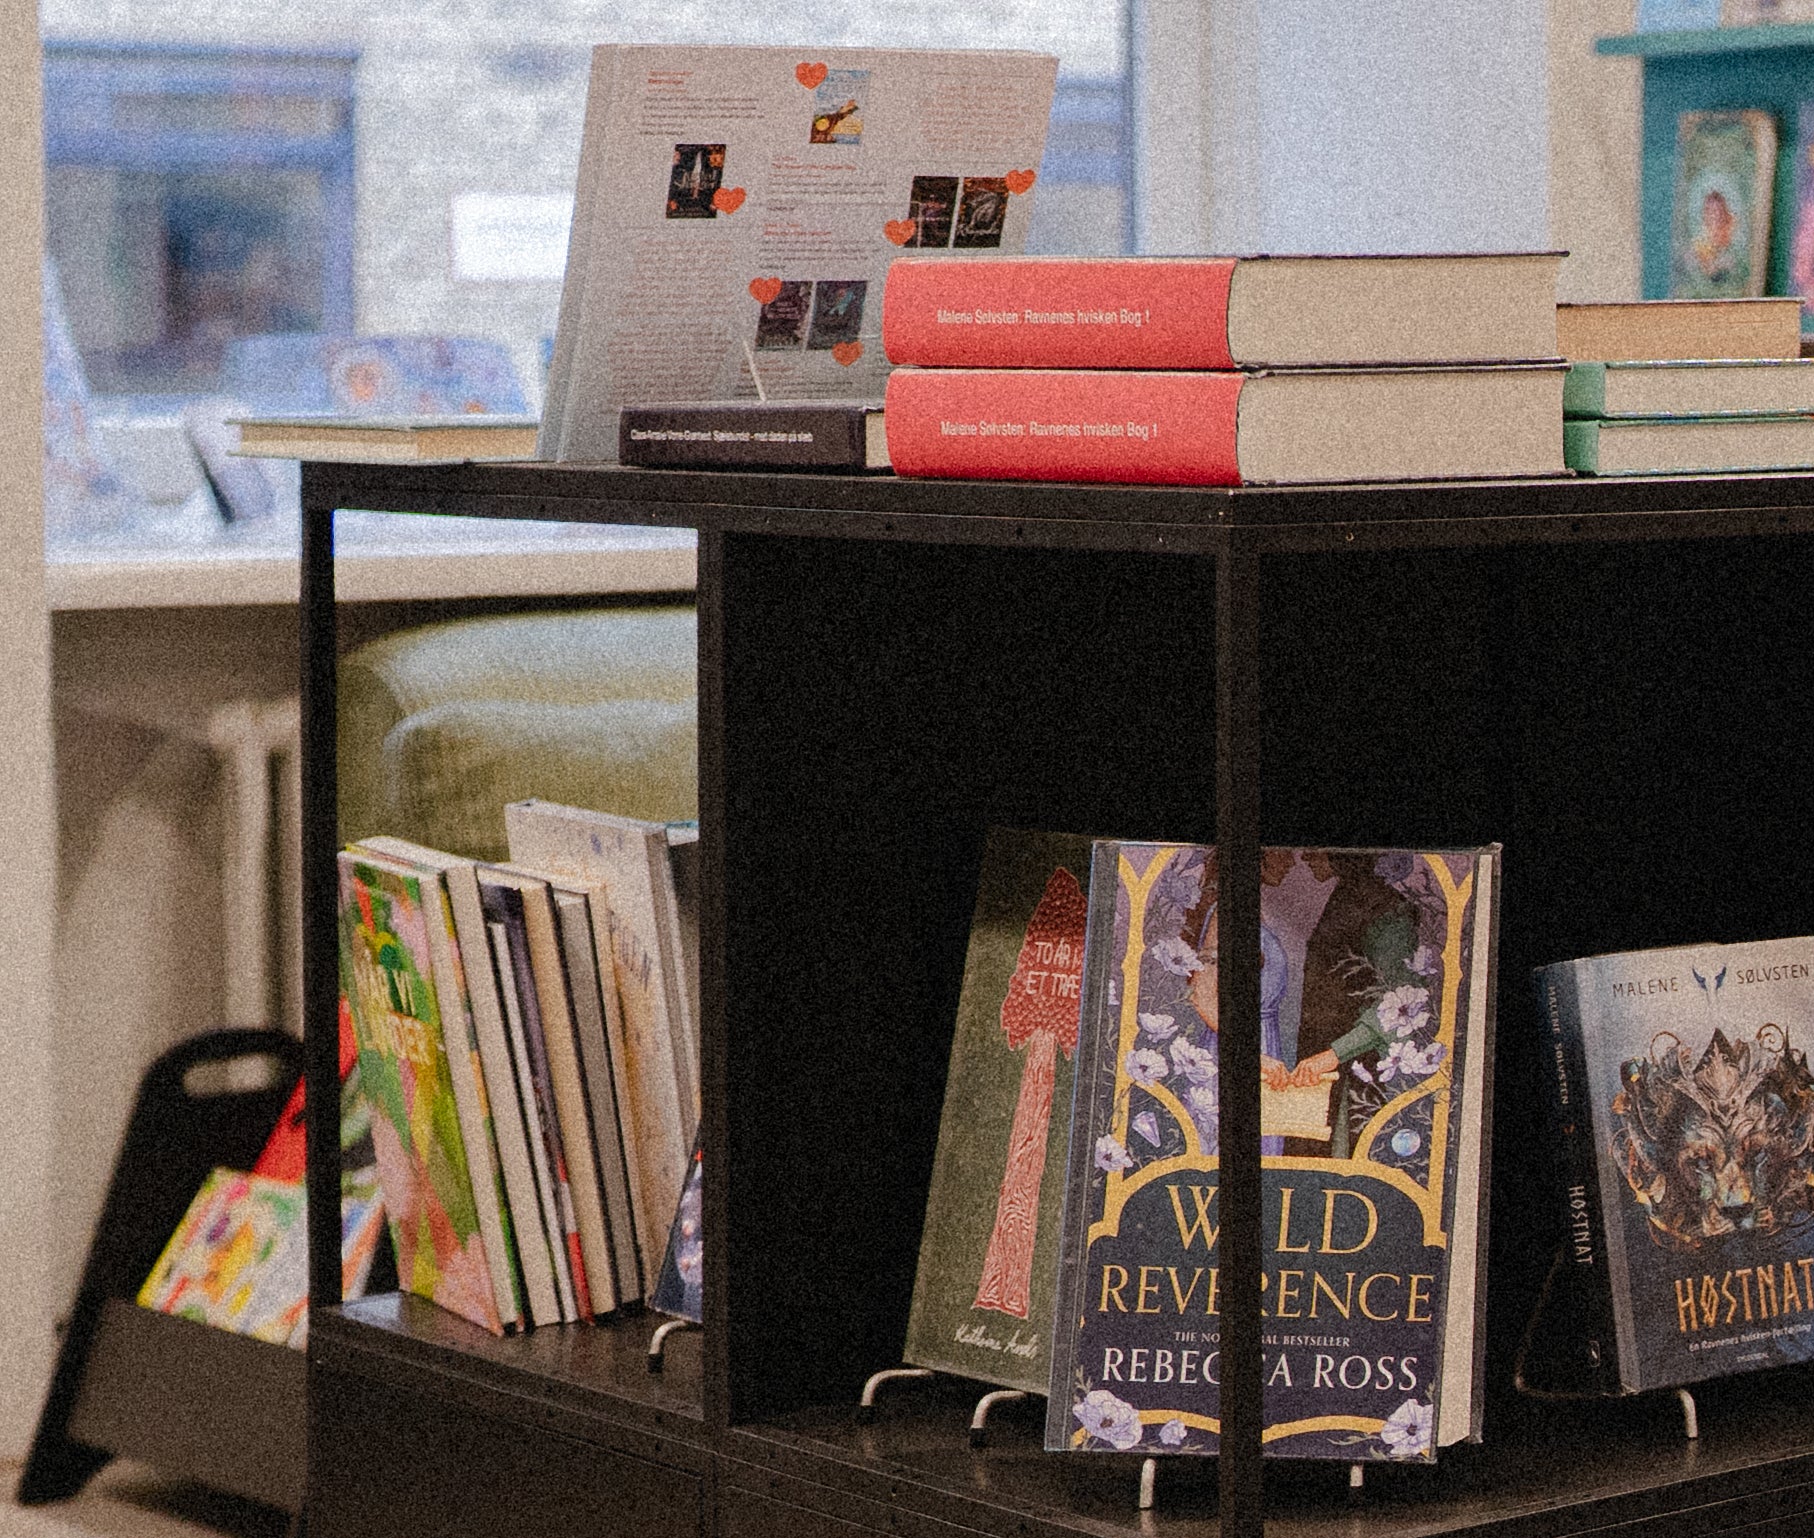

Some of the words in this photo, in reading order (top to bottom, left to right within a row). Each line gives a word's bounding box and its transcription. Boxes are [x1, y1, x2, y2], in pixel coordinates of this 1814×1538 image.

[1024, 309, 1075, 325] Ravnenes
[1077, 308, 1118, 324] hvisken
[1119, 309, 1141, 326] Bog
[1030, 421, 1081, 437] Ravnenes
[1083, 420, 1124, 437] hvisken
[1126, 421, 1150, 441] Bog
[1736, 962, 1811, 986] SØLVSTEN
[1611, 975, 1680, 997] MALENE
[1165, 1183, 1379, 1256] WLD
[1173, 1330, 1197, 1343] THE
[1101, 1346, 1295, 1388] REBECA
[1312, 1352, 1420, 1392] ROSS
